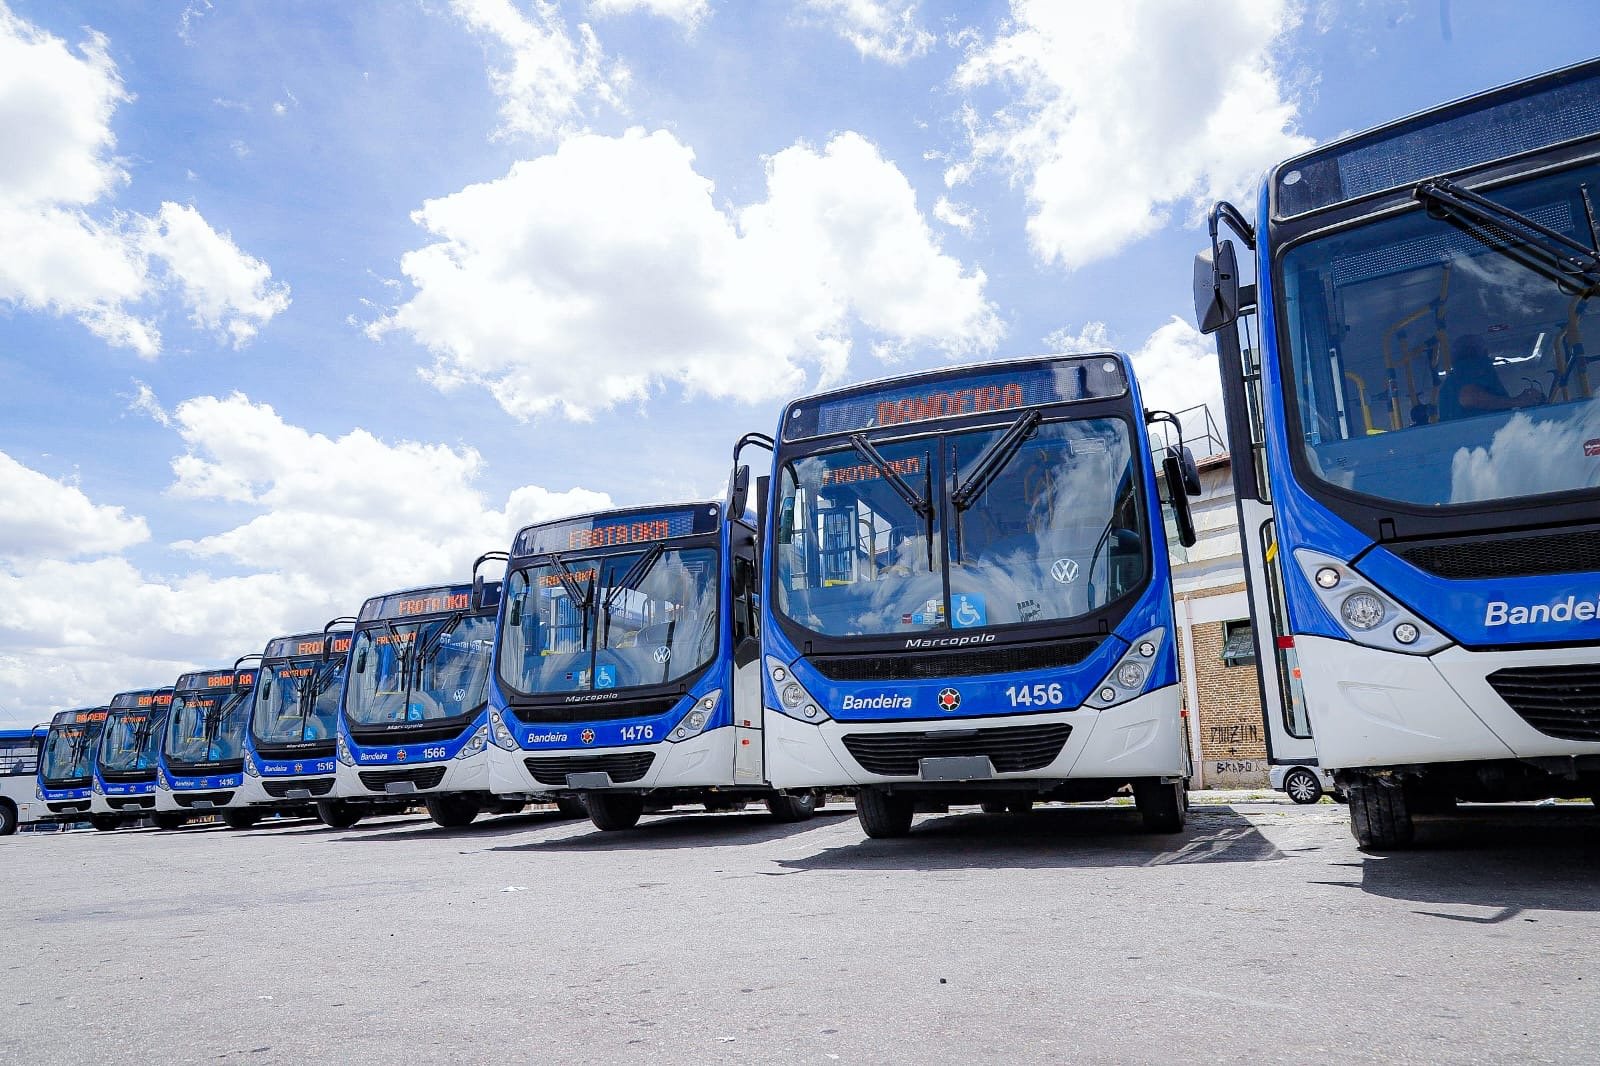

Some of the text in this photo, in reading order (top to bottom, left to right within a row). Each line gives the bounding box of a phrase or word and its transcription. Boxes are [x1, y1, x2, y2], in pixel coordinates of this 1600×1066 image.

[878, 383, 1023, 427] BANDEIRA
[569, 525, 628, 550] FROTA
[905, 633, 996, 648] Marcopolo
[207, 674, 253, 688] BANDRA
[565, 692, 618, 703] Marcopolo
[842, 683, 1063, 710] Bandeira 1456
[527, 725, 654, 743] Bandeira 1476
[360, 747, 446, 761] Bandeira 1566
[316, 761, 334, 772] 1516
